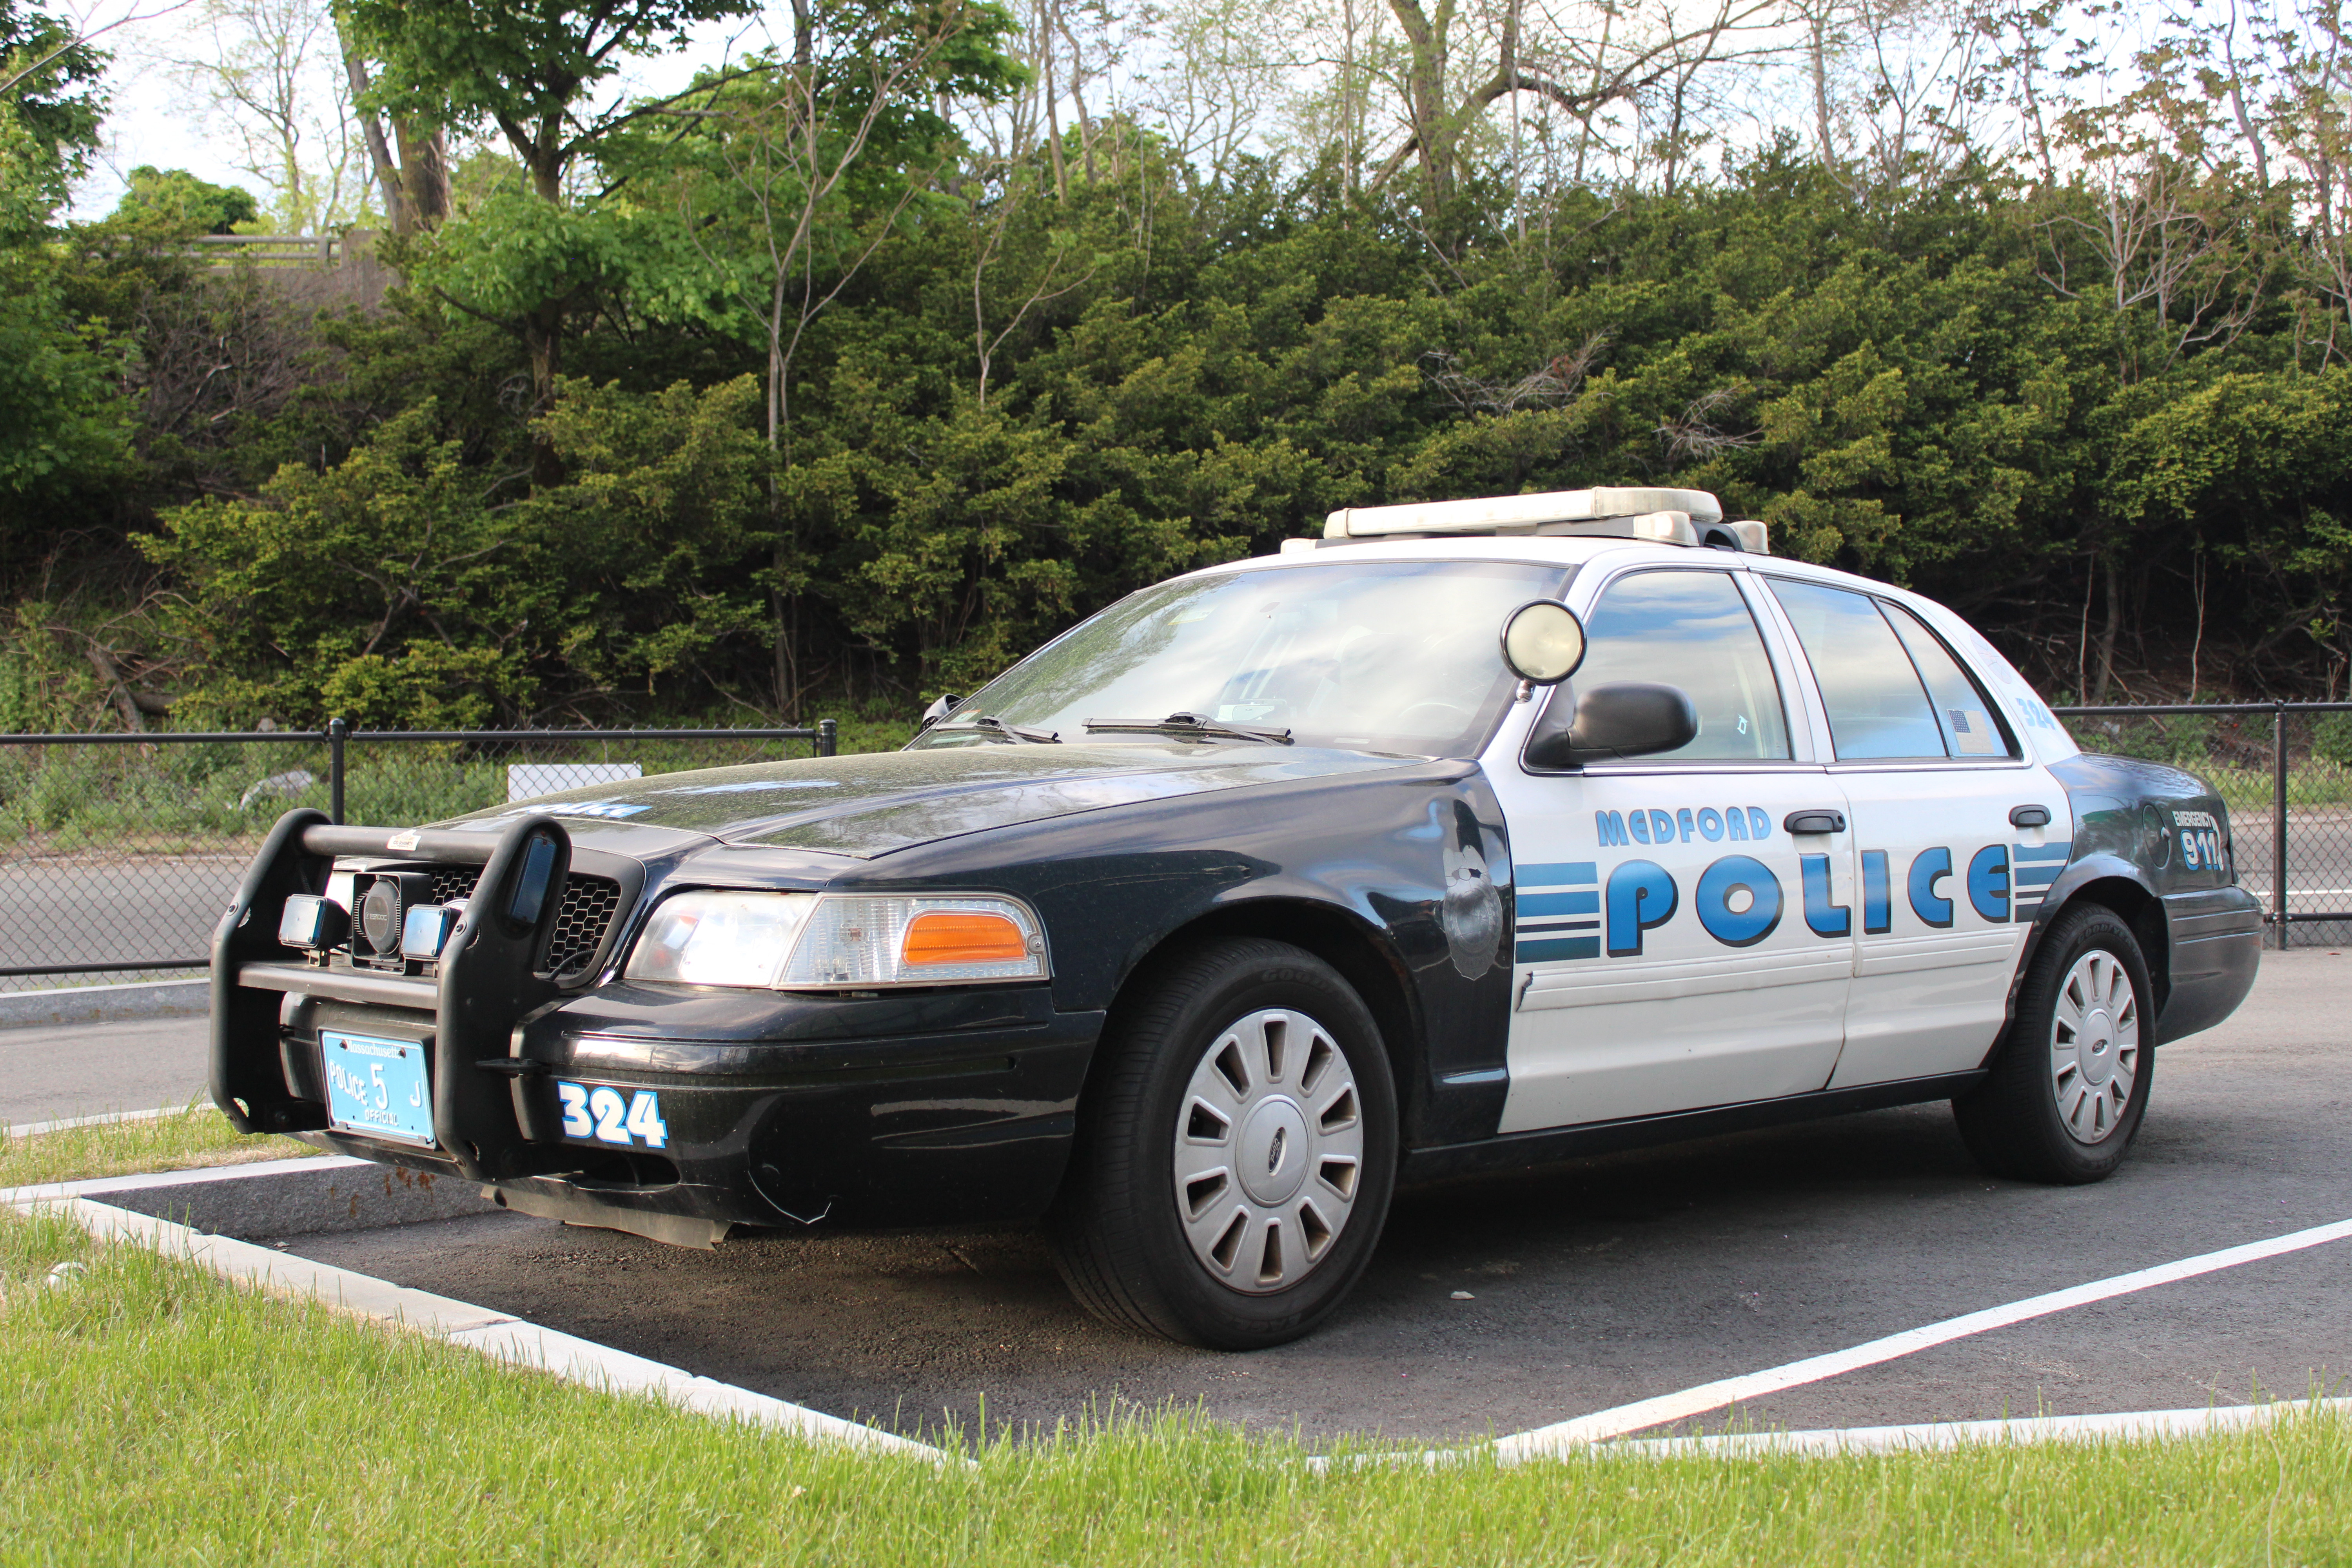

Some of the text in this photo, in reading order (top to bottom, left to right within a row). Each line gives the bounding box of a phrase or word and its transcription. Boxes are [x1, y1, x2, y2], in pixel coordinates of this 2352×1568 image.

[2015, 698, 2056, 730] 324
[498, 803, 652, 818] POLICE
[1595, 806, 1771, 847] MEDFORD
[2172, 811, 2212, 827] EMERGENCY
[2180, 829, 2219, 870] 911
[1606, 844, 2011, 957] POLICE
[329, 1058, 422, 1110] POLICE 5 J
[365, 1108, 399, 1126] OFFICIAL
[558, 1081, 669, 1149] 324
[1270, 1138, 1281, 1163] Ford
